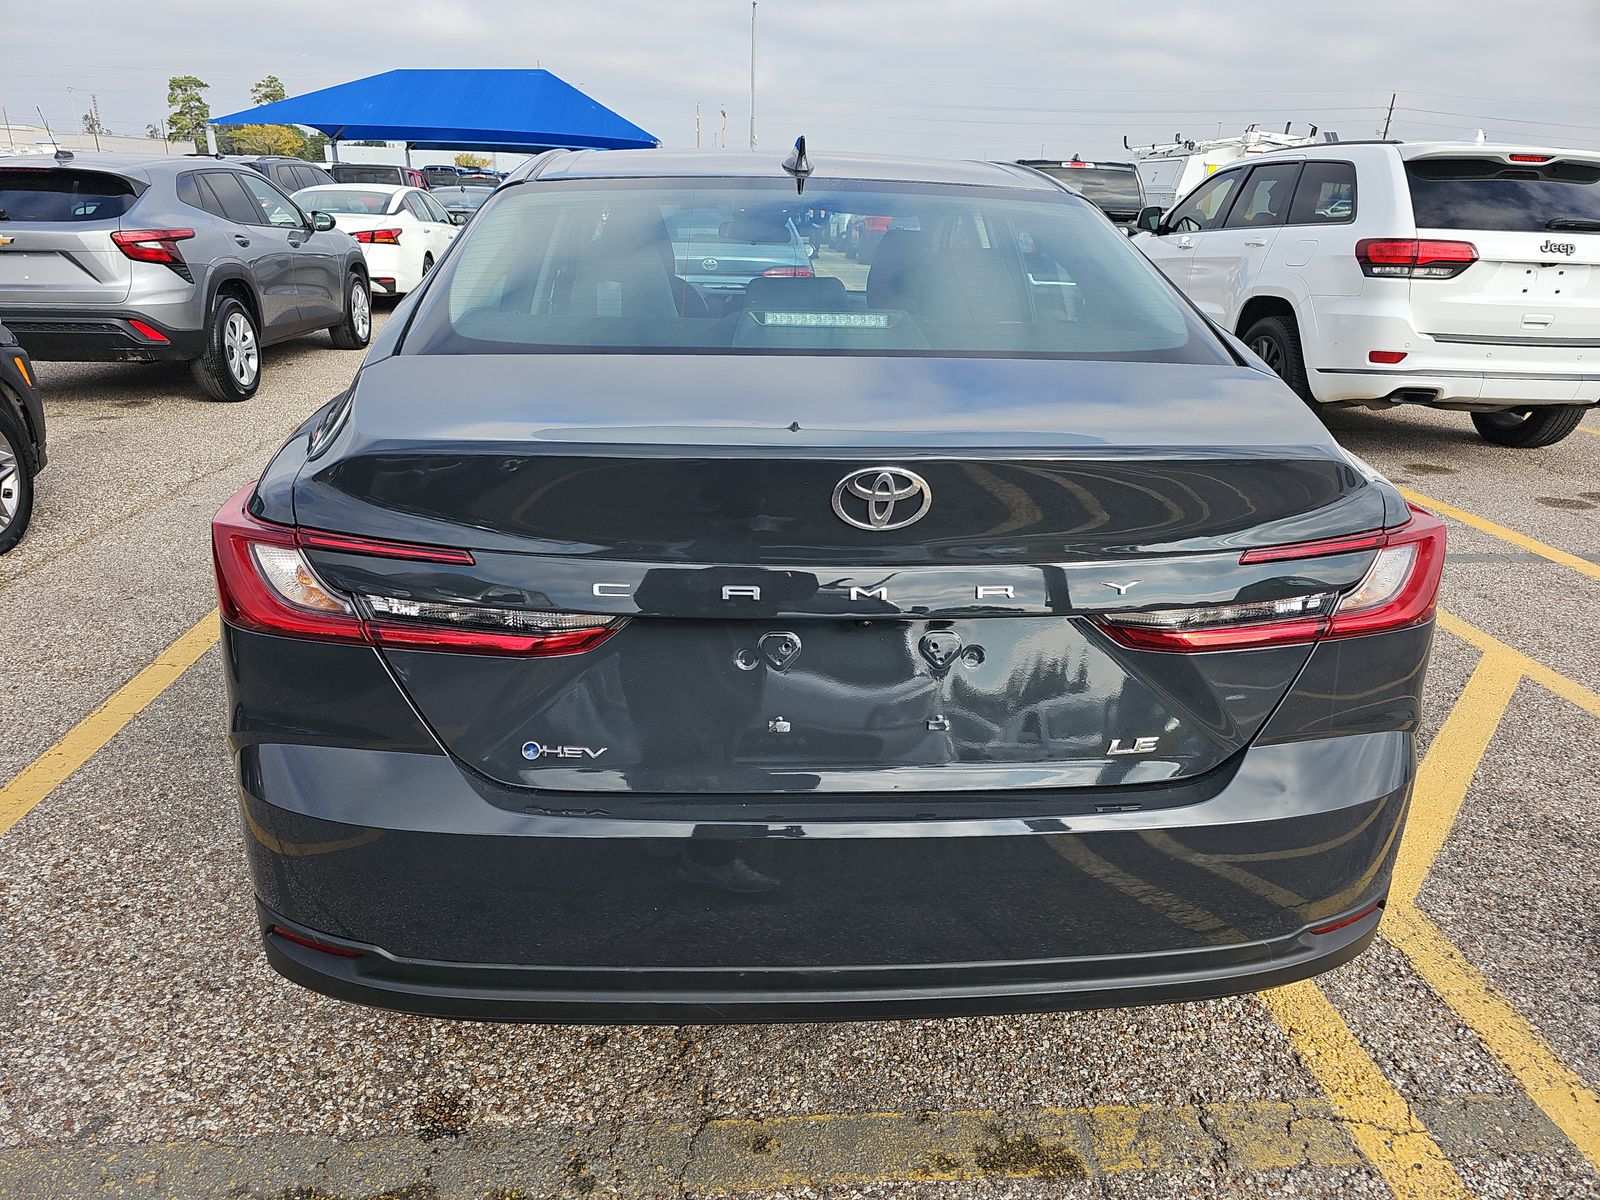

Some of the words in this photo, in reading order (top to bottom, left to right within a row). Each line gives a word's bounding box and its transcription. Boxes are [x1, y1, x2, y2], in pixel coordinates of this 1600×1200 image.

[1540, 240, 1576, 256] Jeep
[592, 579, 1143, 601] CAMRY
[542, 744, 608, 759] HEV
[1105, 736, 1160, 756] LE
